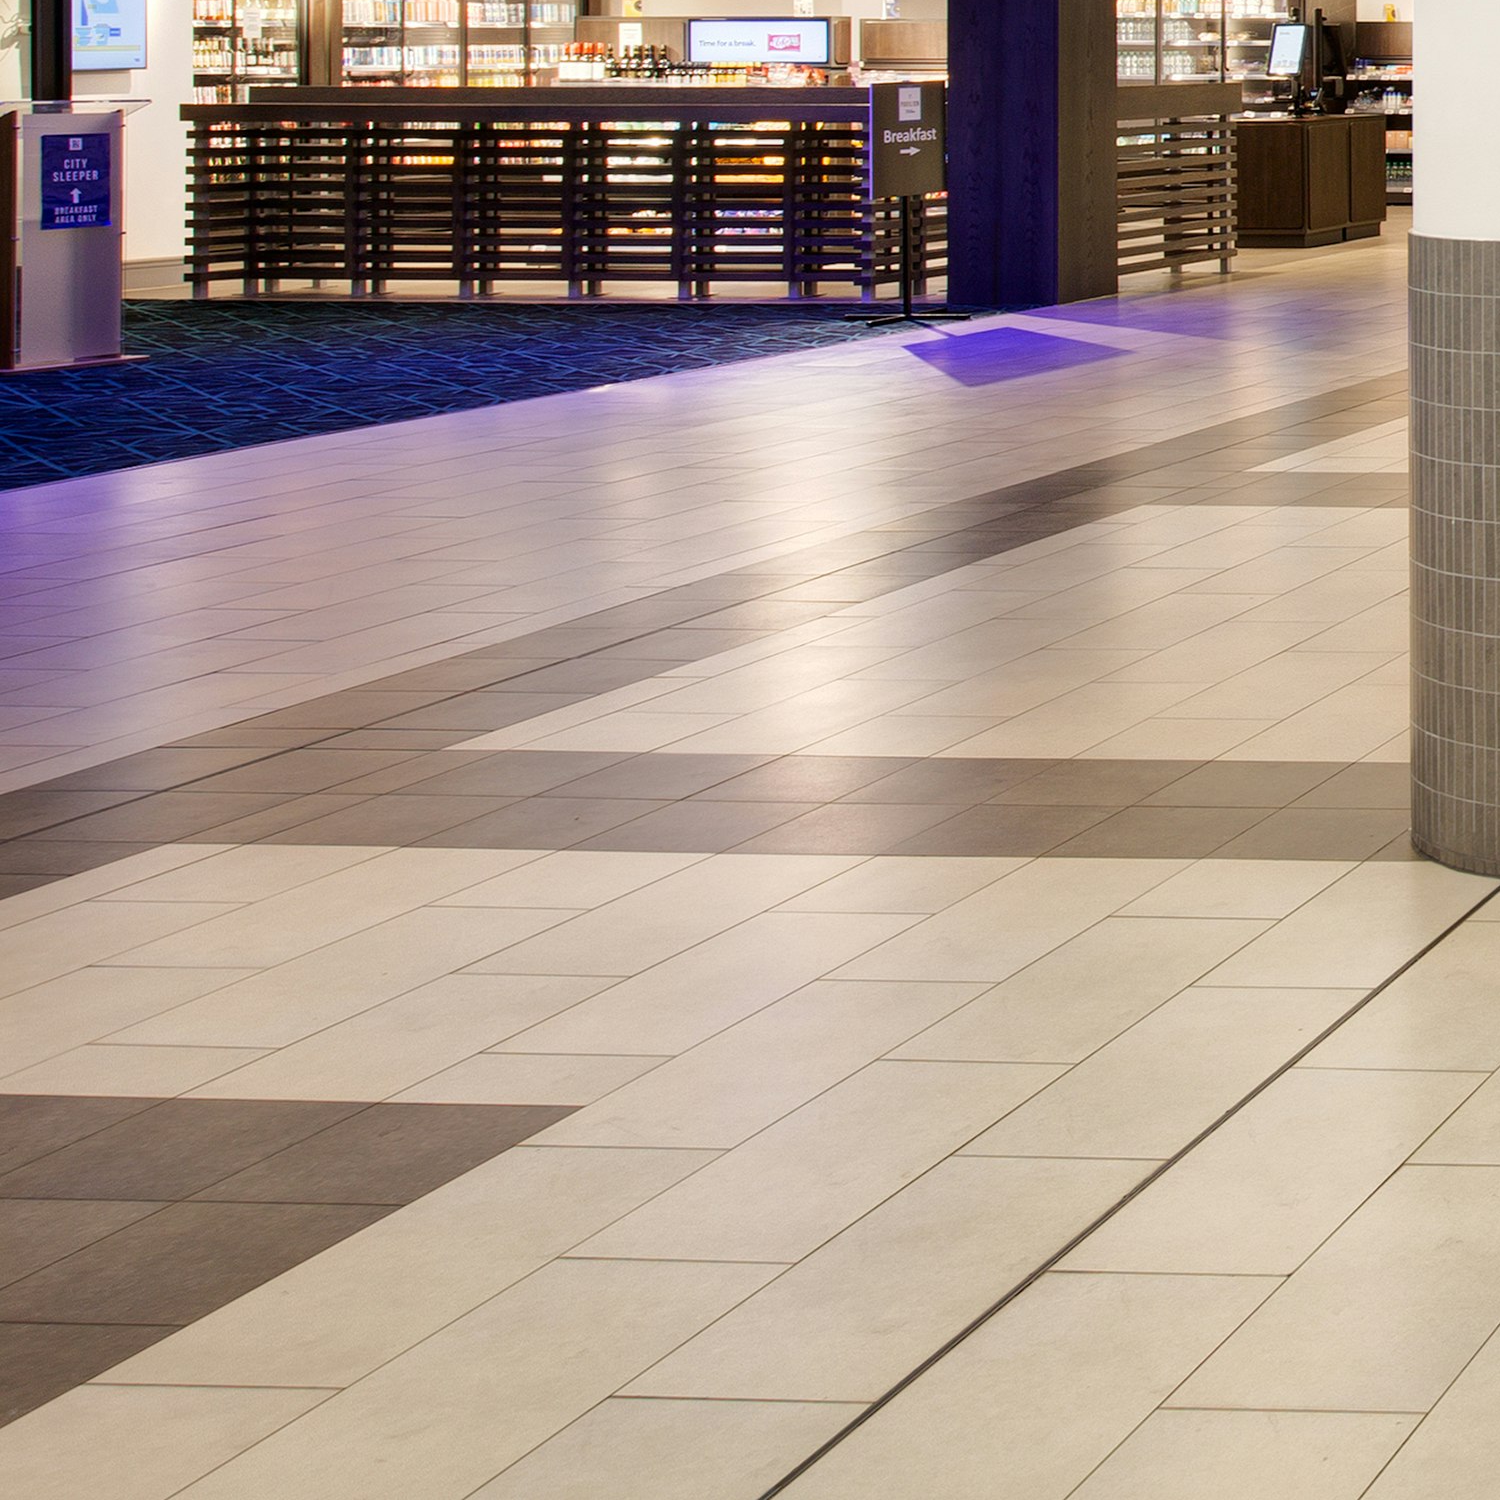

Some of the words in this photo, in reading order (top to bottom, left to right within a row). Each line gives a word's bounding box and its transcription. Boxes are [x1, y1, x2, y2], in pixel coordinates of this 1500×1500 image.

[883, 127, 937, 143] Breakfast
[64, 159, 88, 169] CITY
[53, 170, 99, 182] SLEEPER
[54, 205, 98, 215] BREAKFAST
[77, 214, 97, 222] ONLY
